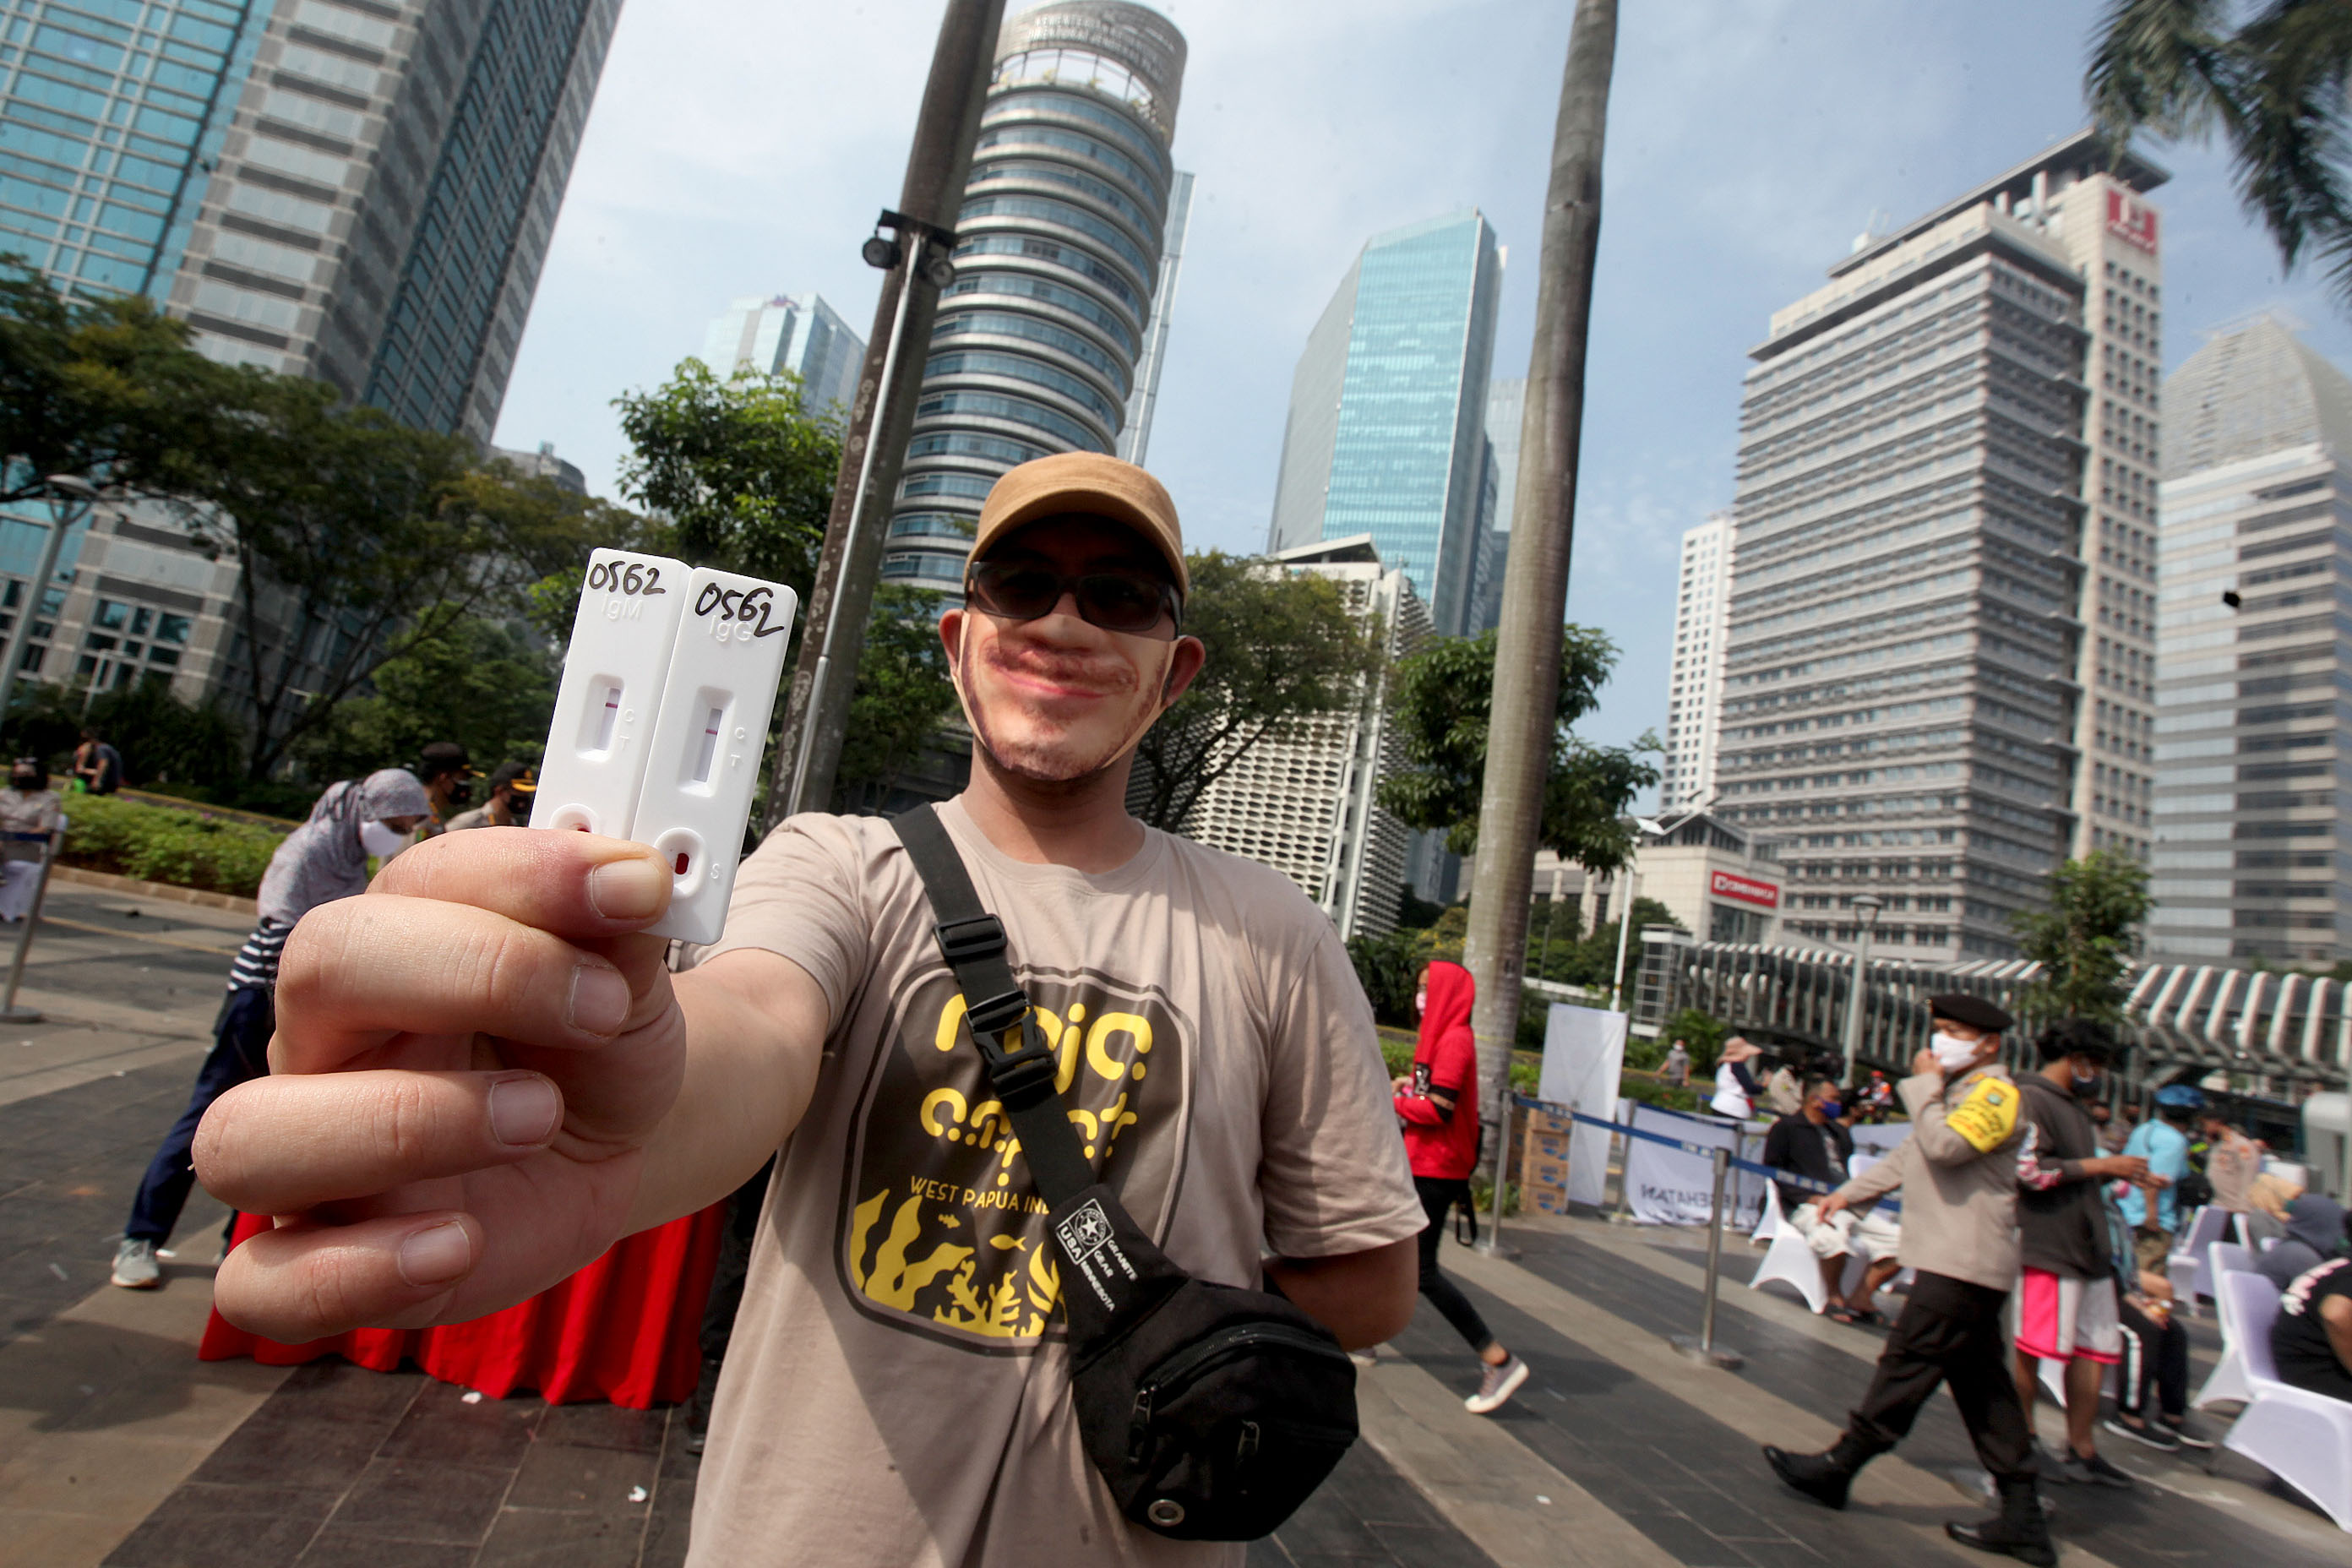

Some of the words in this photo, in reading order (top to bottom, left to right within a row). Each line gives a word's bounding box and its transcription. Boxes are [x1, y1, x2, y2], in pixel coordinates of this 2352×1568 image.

[589, 561, 666, 595] 0562
[694, 582, 784, 637] 0562
[911, 1175, 960, 1203] WEST
[962, 1189, 1020, 1211] PAPUA
[1060, 1225, 1082, 1259] USA
[1094, 1250, 1114, 1277] GEAR
